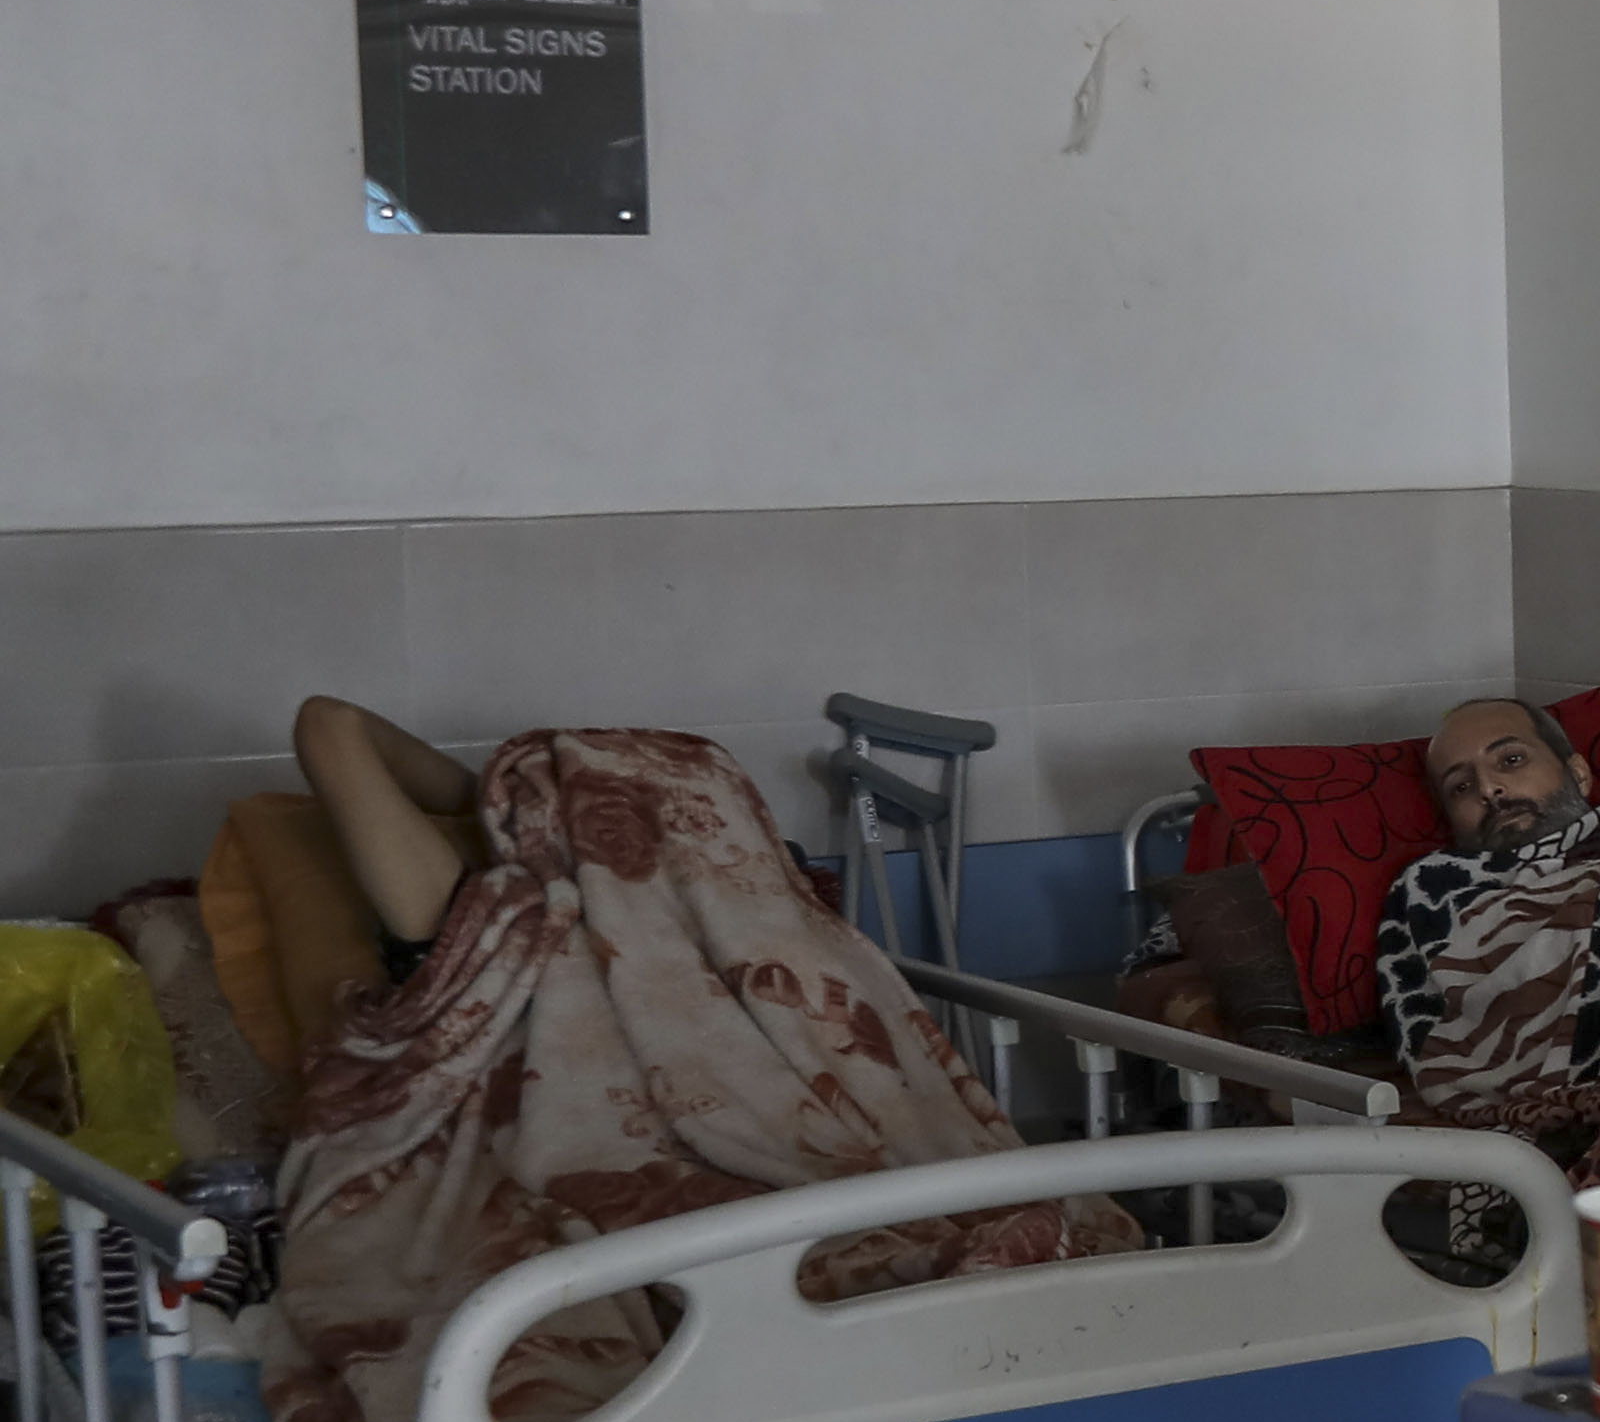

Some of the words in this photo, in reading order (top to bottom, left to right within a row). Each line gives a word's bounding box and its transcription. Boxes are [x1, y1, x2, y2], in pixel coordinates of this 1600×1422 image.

[407, 23, 498, 55] VITAL
[504, 27, 607, 58] SIGNS
[408, 65, 544, 96] STATION
